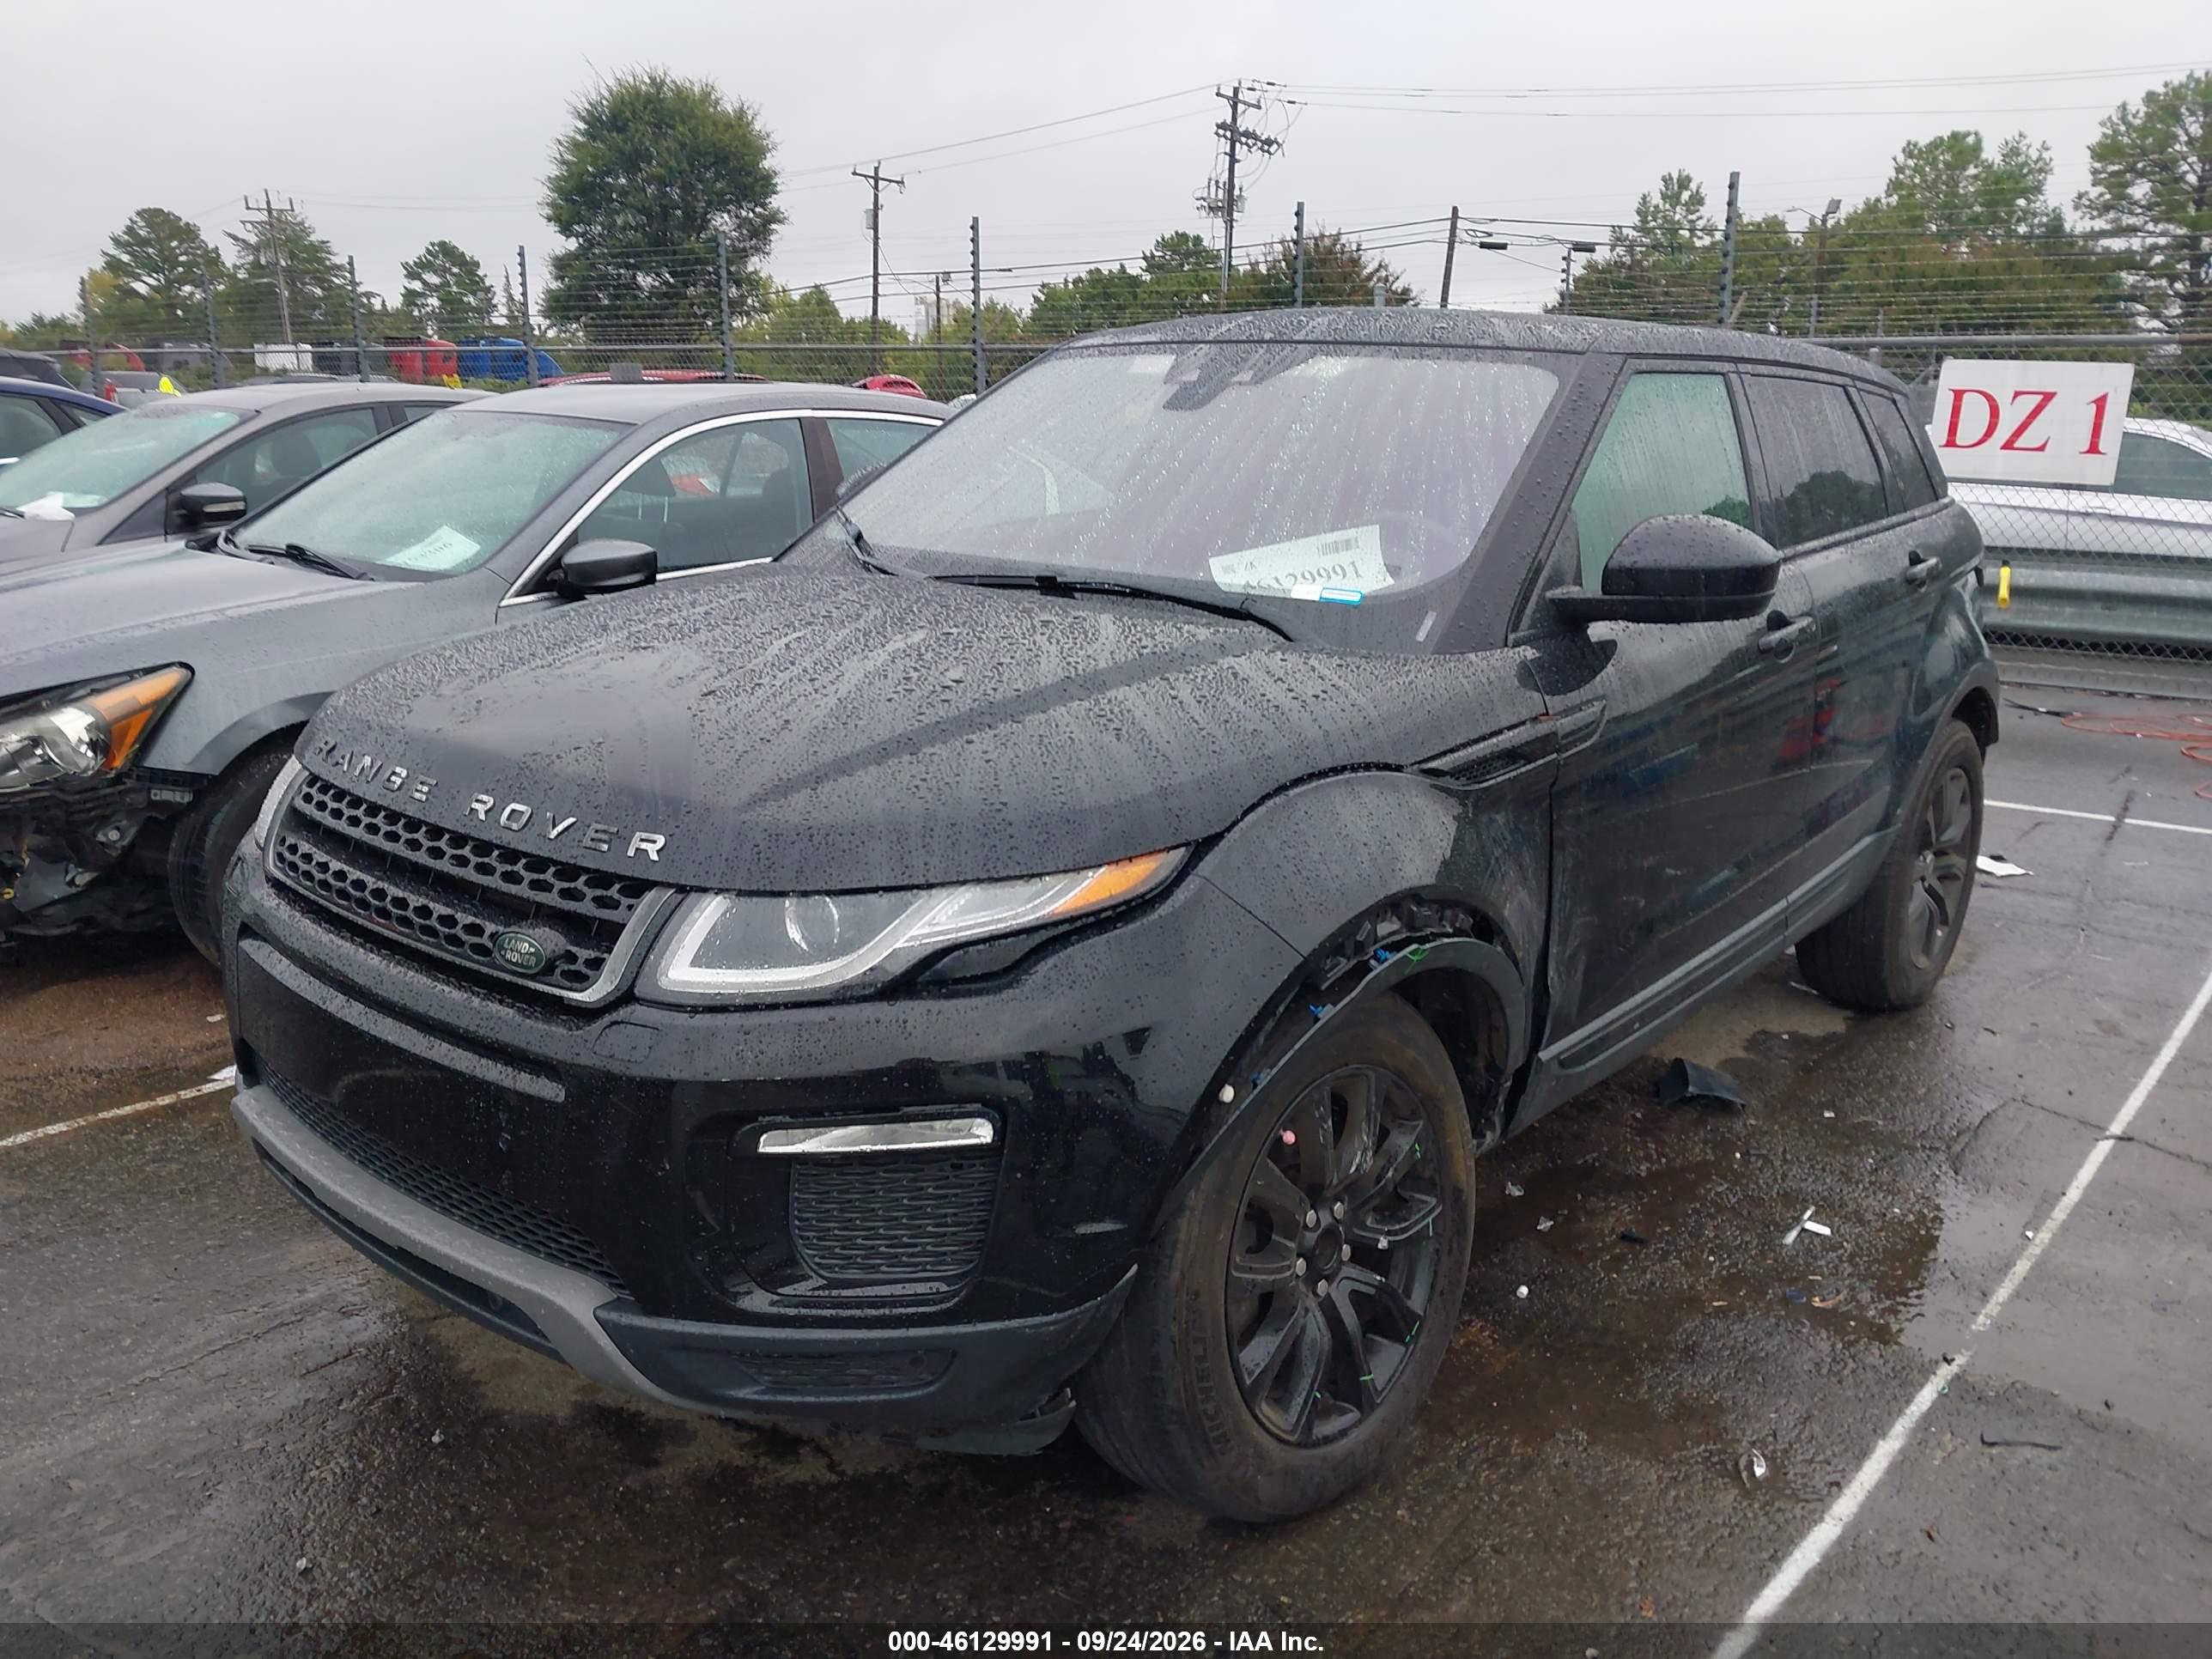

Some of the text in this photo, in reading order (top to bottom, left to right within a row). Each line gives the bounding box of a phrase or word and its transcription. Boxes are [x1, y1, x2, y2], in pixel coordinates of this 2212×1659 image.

[1938, 388, 2109, 455] DZ 1
[313, 738, 666, 862] RANGE ROVER
[503, 938, 529, 953] LAND
[505, 949, 537, 968] ROVER
